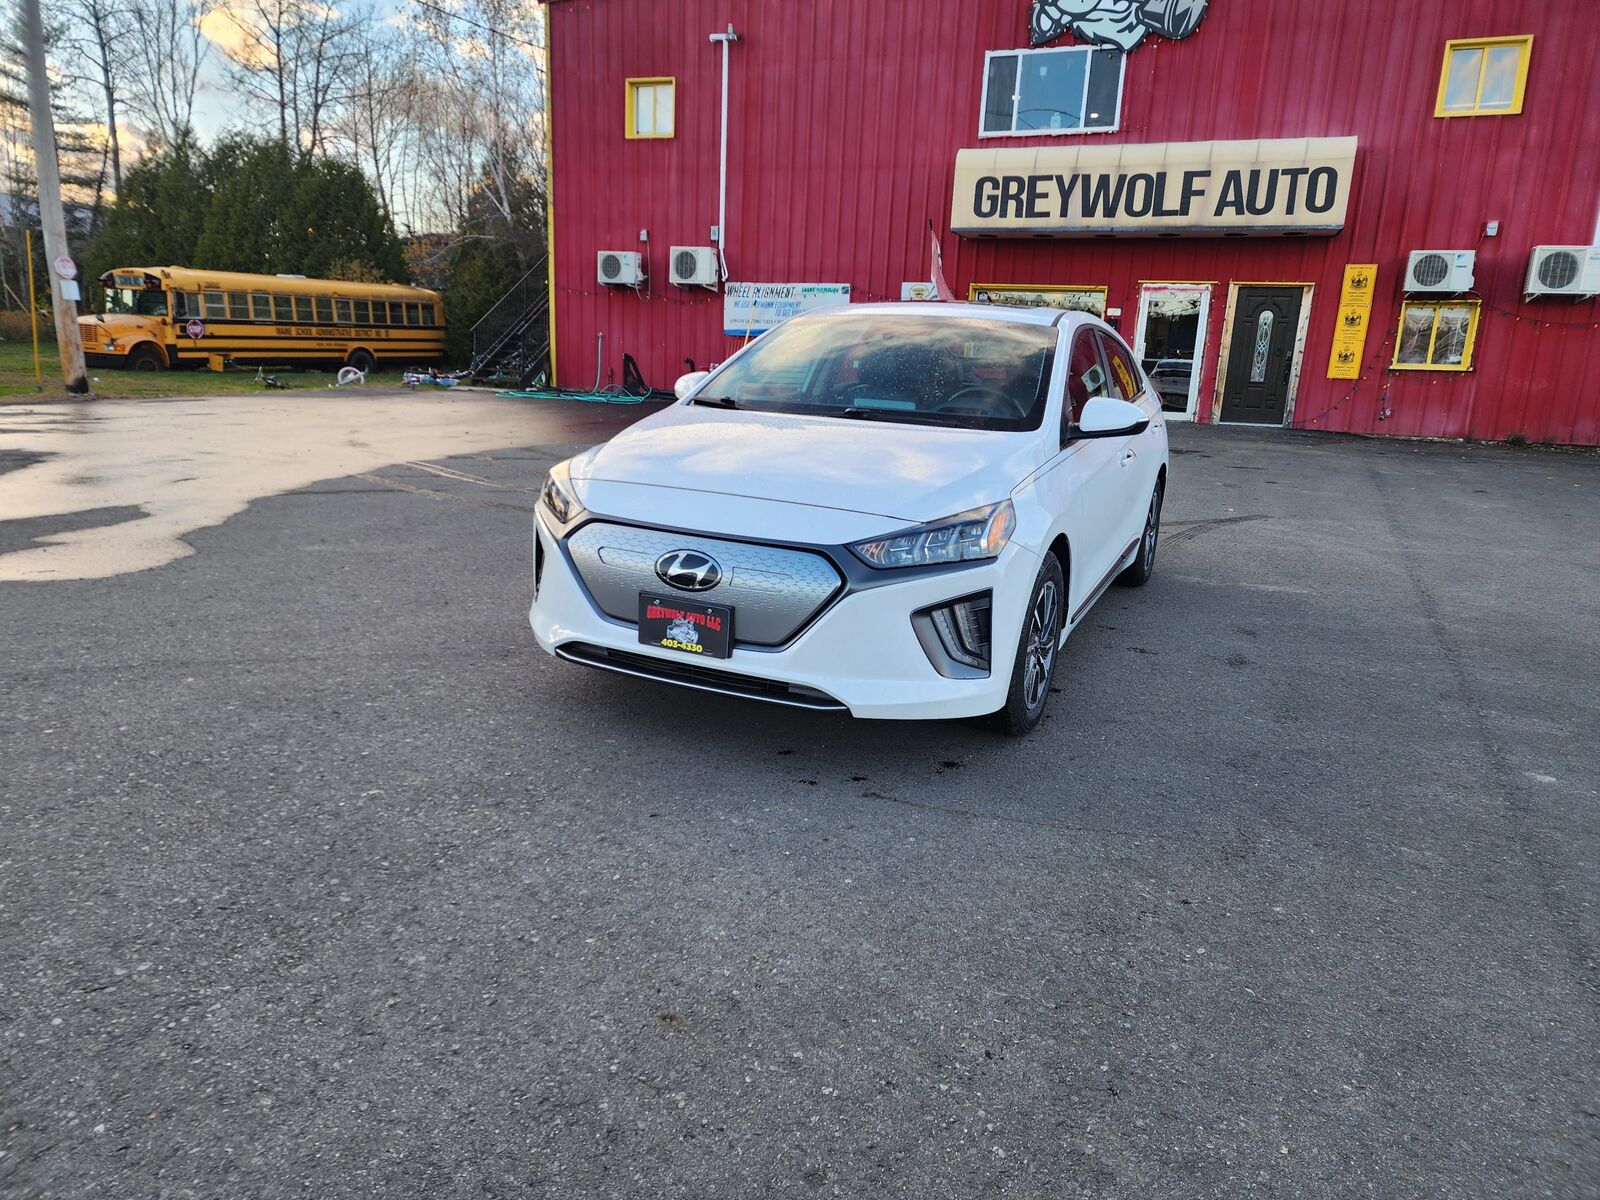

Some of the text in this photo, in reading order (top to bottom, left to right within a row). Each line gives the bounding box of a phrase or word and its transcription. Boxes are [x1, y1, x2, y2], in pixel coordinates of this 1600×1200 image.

[973, 166, 1339, 218] GREYWOLF AUTO
[726, 285, 751, 298] WHEEL
[752, 286, 796, 299] ALIGNMENT
[189, 325, 202, 333] STOP
[275, 327, 293, 335] MAINE
[686, 612, 705, 625] AUTO
[707, 615, 721, 631] LLC
[661, 639, 702, 652] 403-4330
